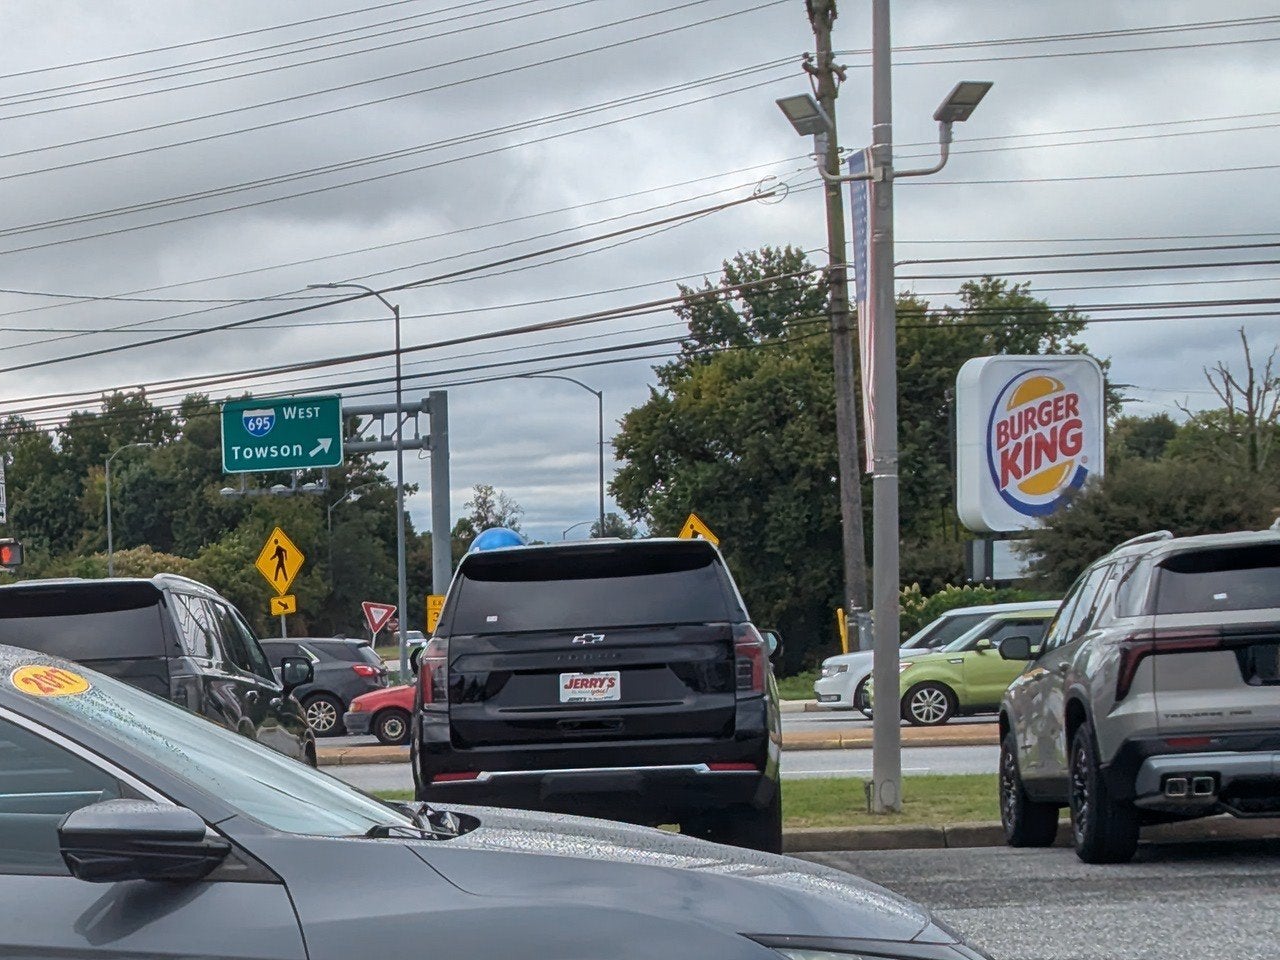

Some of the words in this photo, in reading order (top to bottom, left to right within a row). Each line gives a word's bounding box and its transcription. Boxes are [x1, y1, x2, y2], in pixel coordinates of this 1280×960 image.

[282, 406, 320, 420] WEST
[248, 417, 270, 431] 695
[996, 393, 1079, 450] BURGER
[231, 444, 302, 460] Towson
[1000, 418, 1083, 489] KING
[21, 669, 80, 694] 2017
[563, 676, 617, 690] JERRY'S
